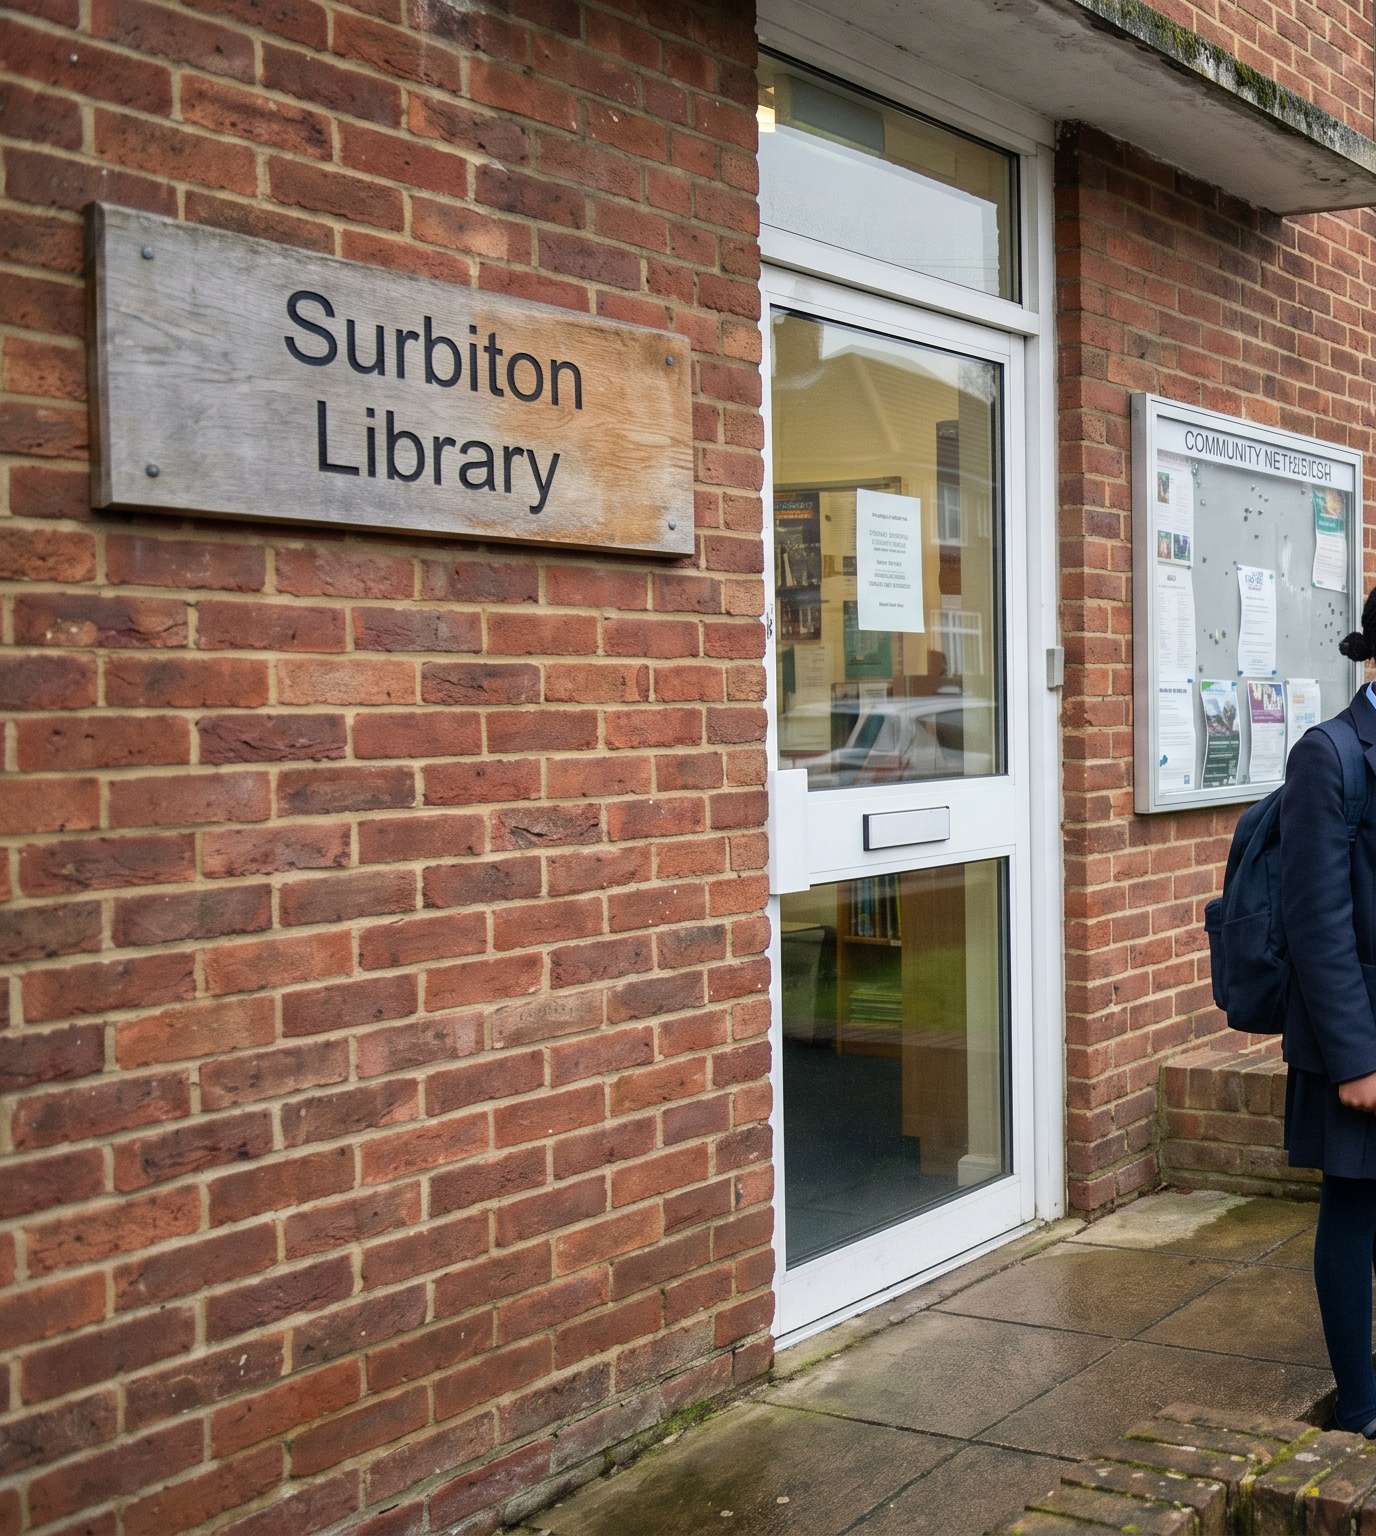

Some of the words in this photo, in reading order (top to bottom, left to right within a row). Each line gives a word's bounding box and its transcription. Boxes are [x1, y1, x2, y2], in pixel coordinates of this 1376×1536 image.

[284, 290, 584, 411] Surbiton
[316, 399, 561, 515] Library
[1184, 430, 1262, 466] COMMUNITY
